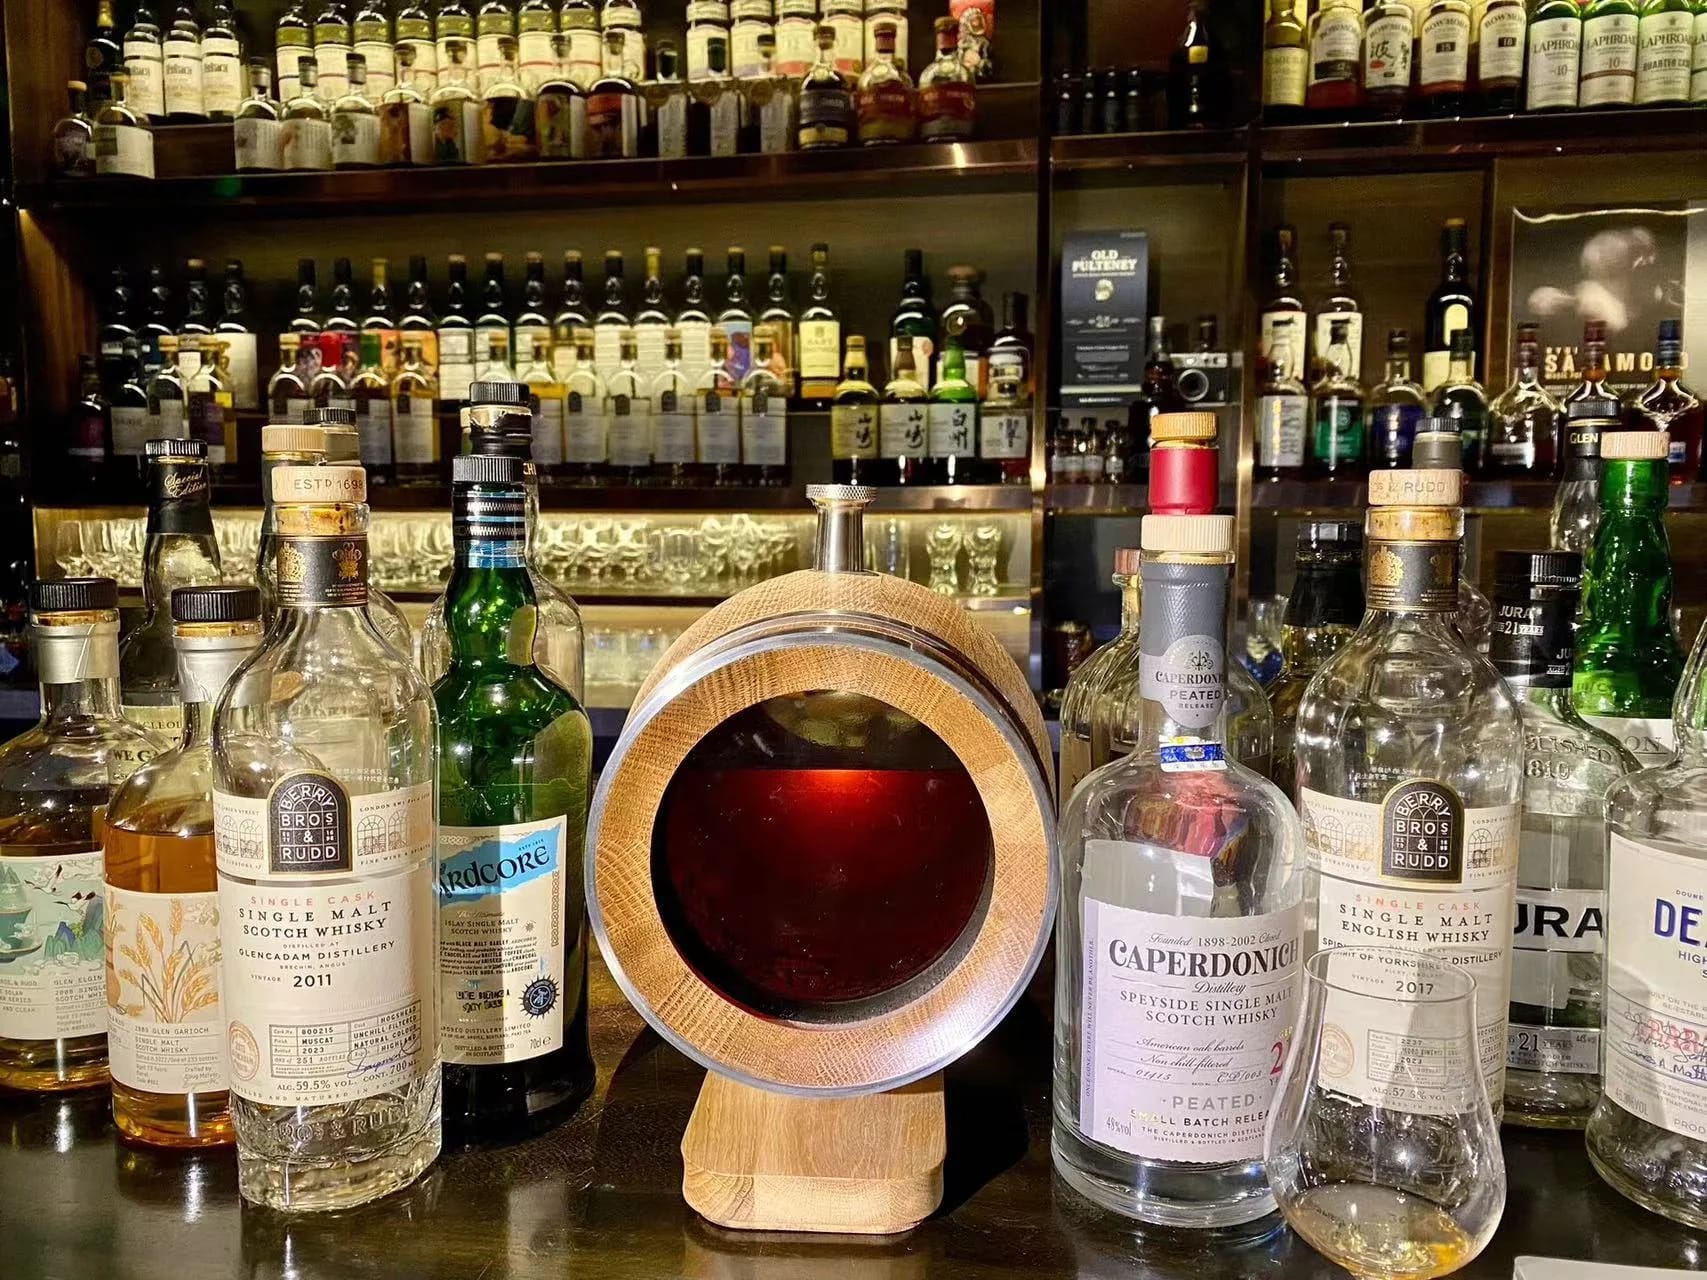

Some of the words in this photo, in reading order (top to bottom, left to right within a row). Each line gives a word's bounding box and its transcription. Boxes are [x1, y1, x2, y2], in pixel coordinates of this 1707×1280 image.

[1090, 250, 1118, 260] OLD
[1571, 432, 1599, 443] GLEN
[1504, 621, 1518, 635] 21
[1556, 648, 1572, 660] JU
[1170, 690, 1222, 700] PEATED
[280, 785, 335, 810] BERRY
[1397, 793, 1451, 817] BERRY
[281, 812, 334, 827] BROS
[1396, 821, 1449, 835] BROS
[303, 829, 314, 843] &
[1417, 838, 1429, 851] &
[281, 846, 336, 860] RUDD
[1394, 853, 1449, 868] RUDD
[250, 896, 314, 907] SINGLE
[327, 890, 375, 905] CASK
[1355, 893, 1424, 910] SINGLE
[1437, 902, 1480, 911] CASK
[239, 907, 315, 922] SINGLE
[331, 901, 392, 920] MALT
[1339, 903, 1424, 926] SINGLE
[1440, 913, 1493, 927] MALT
[243, 924, 308, 938] SCOTCH
[315, 918, 387, 938] WHISKY
[466, 919, 496, 927] SINGLE
[498, 918, 519, 926] MALT
[1654, 898, 1707, 946] DE
[451, 927, 480, 935] SCOTCH
[1341, 920, 1418, 941] ENGLISH
[1425, 930, 1490, 943] WHISKY
[1150, 932, 1192, 946] Founded
[1198, 935, 1256, 948] 1898-2002
[239, 948, 311, 961] GLENCADAM
[317, 940, 395, 960] DISTILLERY
[1109, 938, 1300, 978] CAPERDONICH
[1359, 952, 1374, 961] OF
[1452, 950, 1502, 965] DISTILLERY
[78, 975, 103, 983] ELGIN
[251, 974, 282, 982] VINTAGE
[293, 973, 332, 988] 2011
[1192, 980, 1247, 996] Distillery
[1395, 980, 1434, 995] 2017
[55, 994, 84, 1002] SCOTCH
[1120, 990, 1199, 1012] SPEYSIDE
[1205, 997, 1261, 1012] SINGLE
[1265, 986, 1294, 1006] MALT
[380, 1005, 417, 1024] HOGSHEAD
[1145, 1010, 1216, 1027] SCOTCH
[1223, 1007, 1279, 1026] WHISKY
[152, 1027, 170, 1035] GLEN
[301, 1027, 334, 1035] 800215
[504, 1023, 531, 1031] LIMITED
[135, 1036, 158, 1045] SINGLE
[301, 1037, 334, 1045] MUSCAT
[353, 1036, 389, 1049] NATURAL
[392, 1023, 417, 1039] COLOUR
[1518, 1032, 1540, 1052] 21
[135, 1044, 158, 1052] SCOTCH
[1136, 1037, 1190, 1052] American
[1192, 1038, 1211, 1052] oak
[1212, 1039, 1245, 1053] barrels
[296, 1056, 314, 1064] 251
[1140, 1054, 1168, 1066] Non
[1170, 1054, 1231, 1075] chill-filtered
[296, 1080, 331, 1091] 59.5%
[389, 1060, 407, 1075] 700
[1172, 1093, 1255, 1111] PEATED
[1183, 1115, 1230, 1127] BATCH
[1142, 1126, 1159, 1134] THE
[1163, 1128, 1229, 1139] CAPERDONICH
